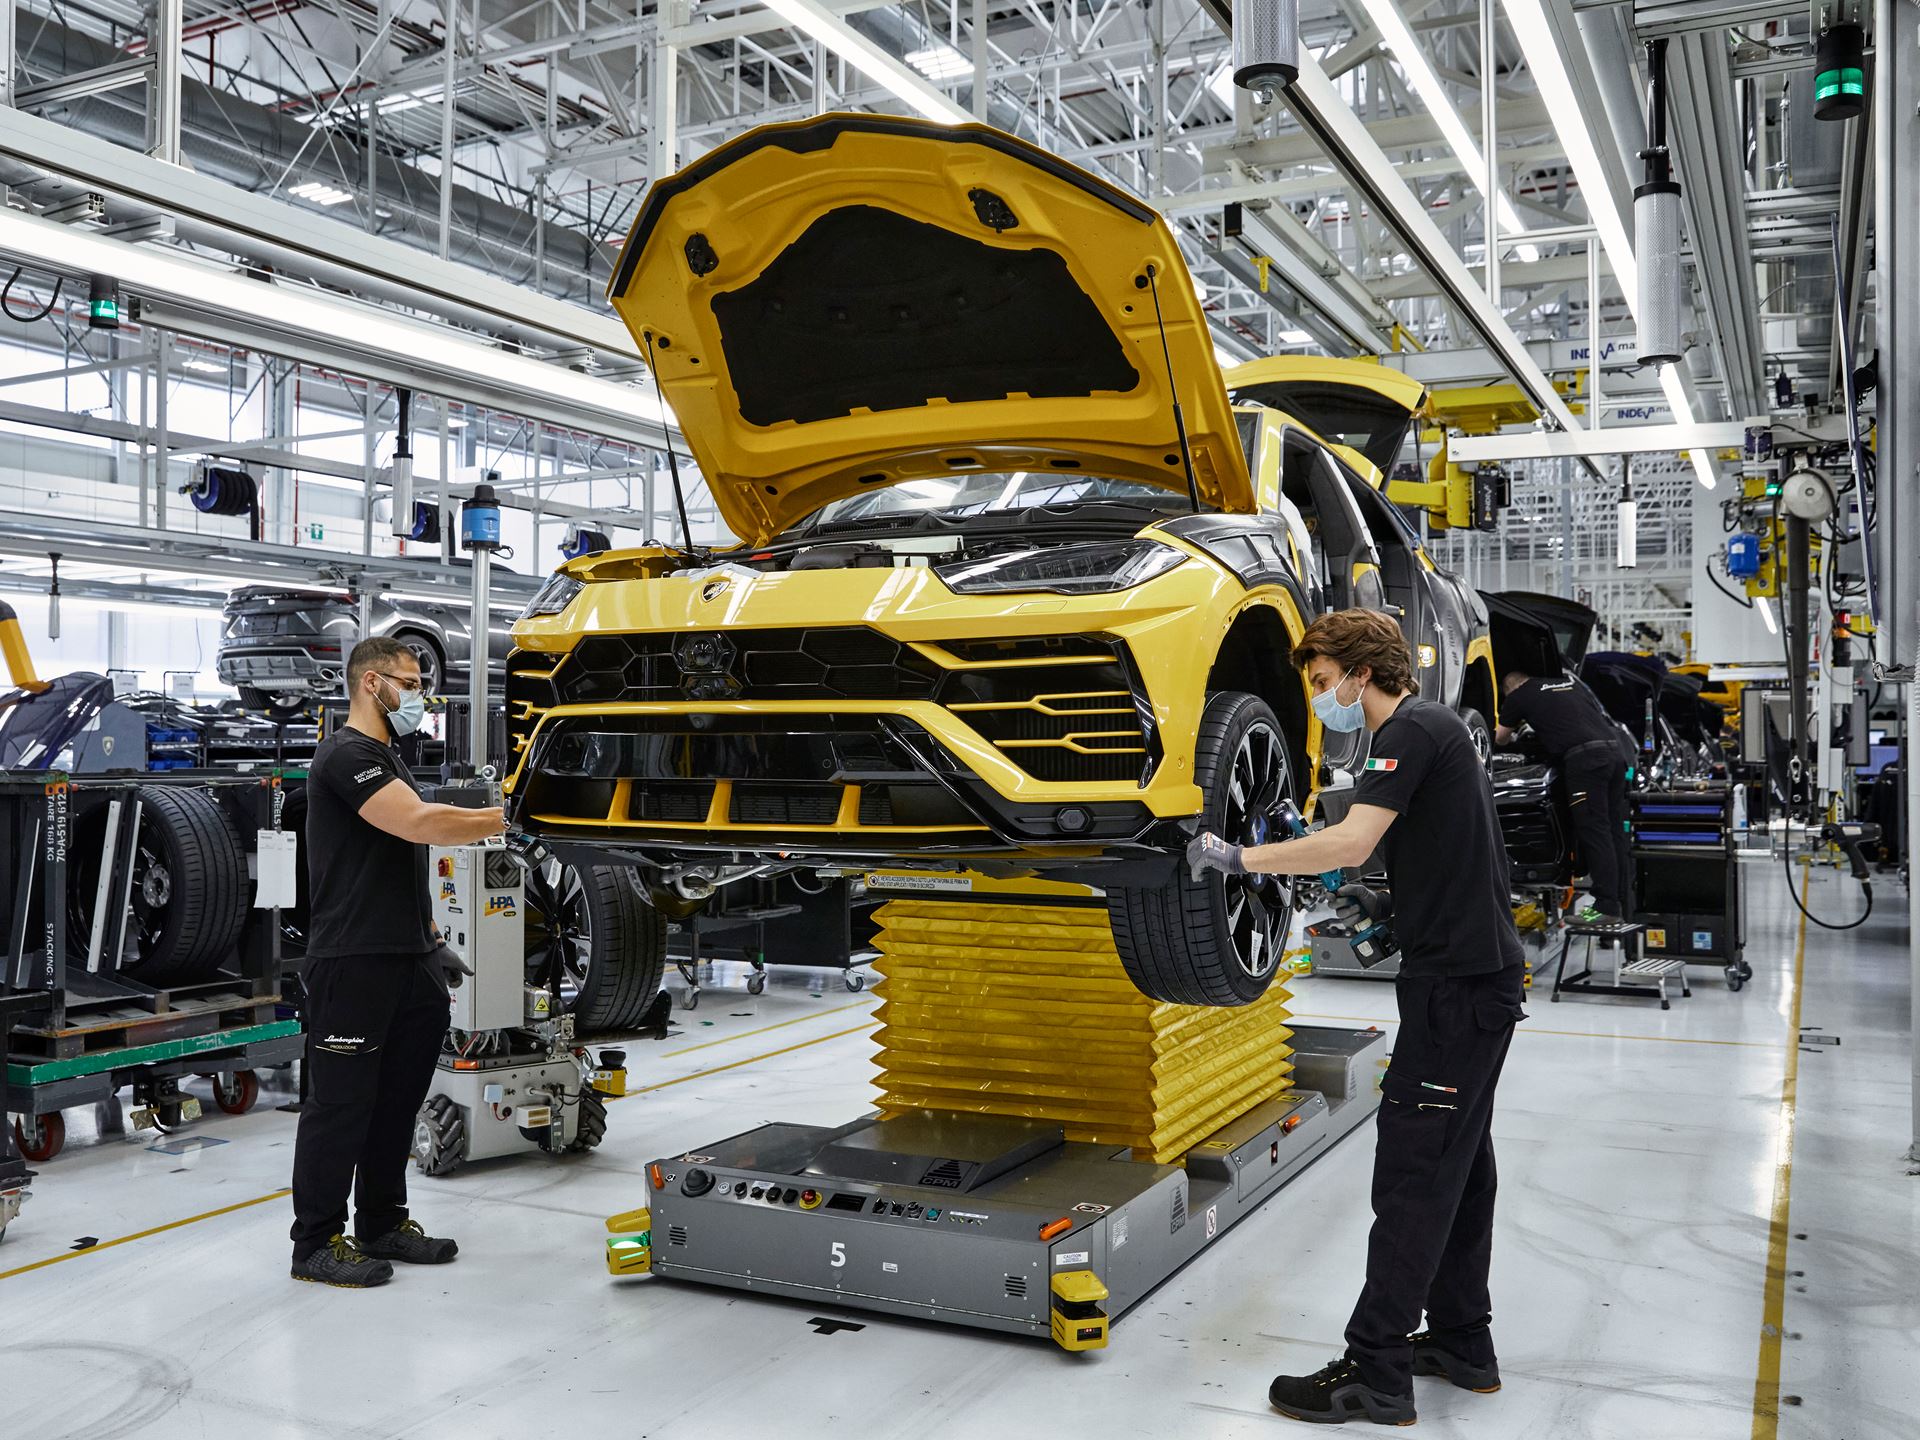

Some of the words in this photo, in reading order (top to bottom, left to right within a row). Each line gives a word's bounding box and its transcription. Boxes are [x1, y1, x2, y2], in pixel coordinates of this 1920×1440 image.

[1571, 343, 1614, 360] INDVA
[1618, 341, 1636, 351] ma
[1618, 406, 1655, 419] INDEVA
[56, 794, 66, 814] 612
[47, 847, 54, 861] KG
[490, 896, 515, 909] HPA
[46, 923, 54, 976] STACKING:
[921, 1177, 958, 1188] CPM
[1171, 1214, 1185, 1233] CPM
[831, 1242, 846, 1267] 5
